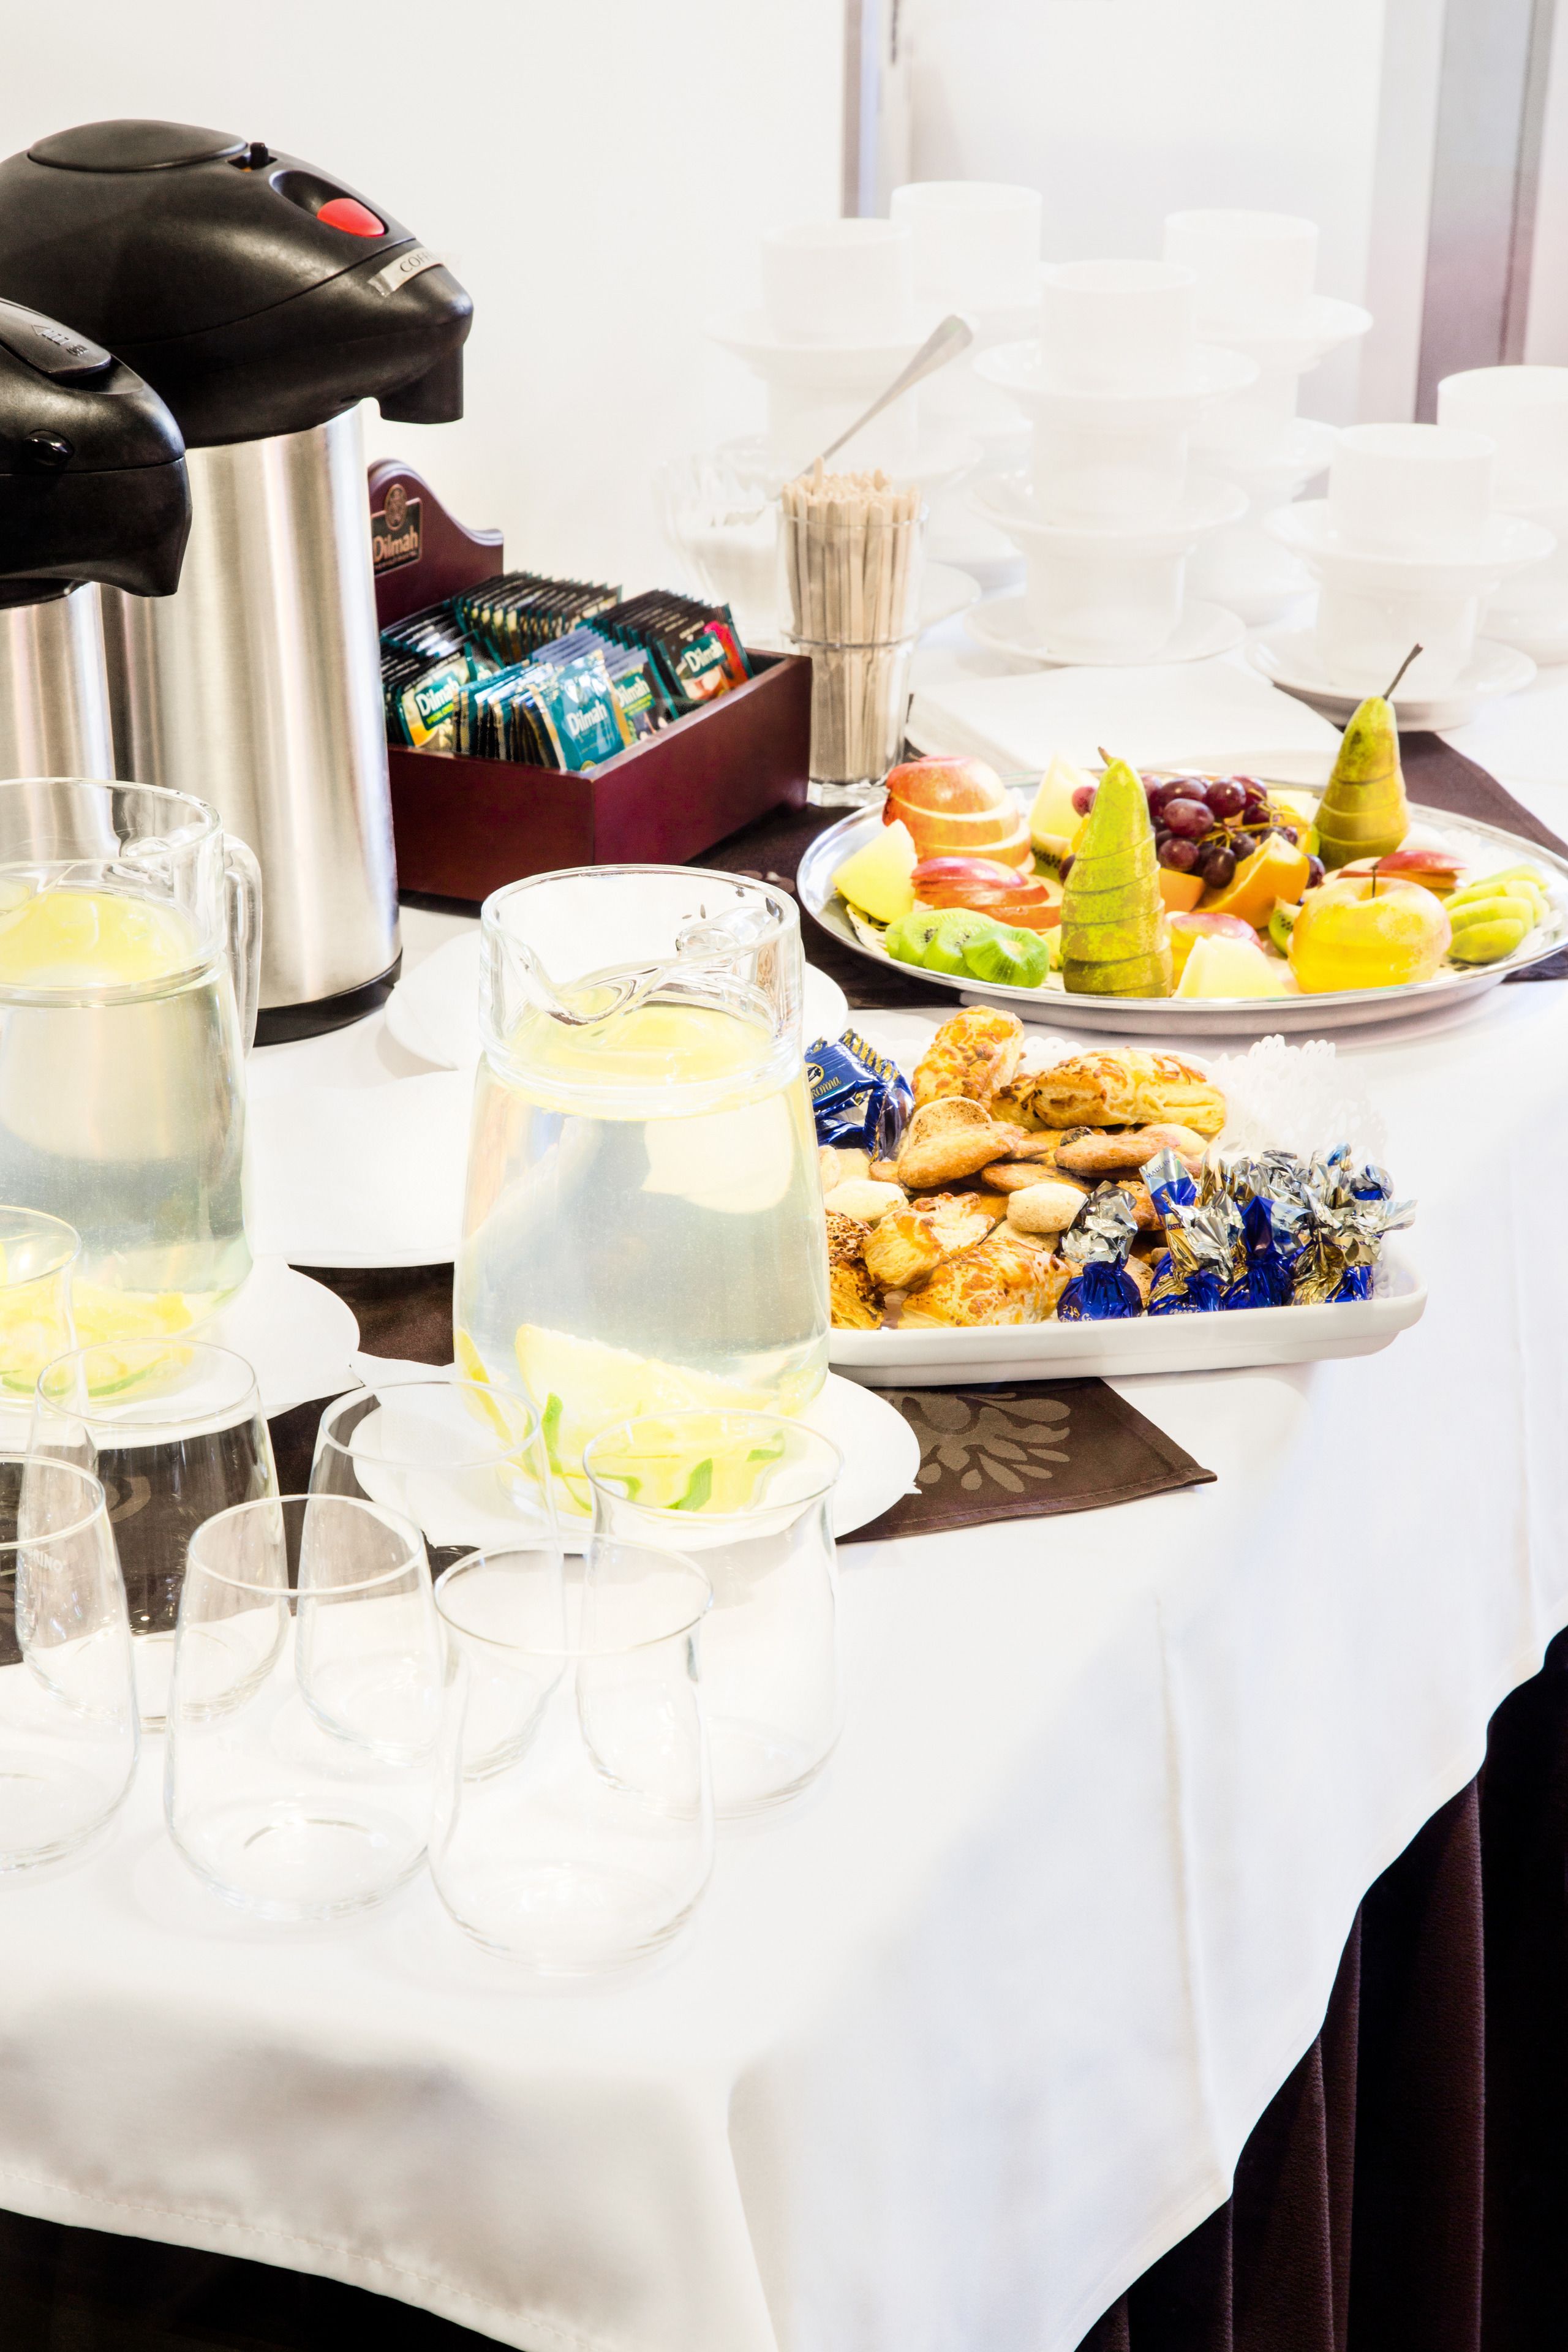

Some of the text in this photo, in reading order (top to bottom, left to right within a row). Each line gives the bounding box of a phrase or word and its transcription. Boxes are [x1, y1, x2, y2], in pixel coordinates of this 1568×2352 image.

[373, 525, 418, 562] Dilmah
[684, 638, 725, 673] Dilmah
[567, 699, 608, 737] Dilmah
[1145, 1165, 1164, 1180] MADE
